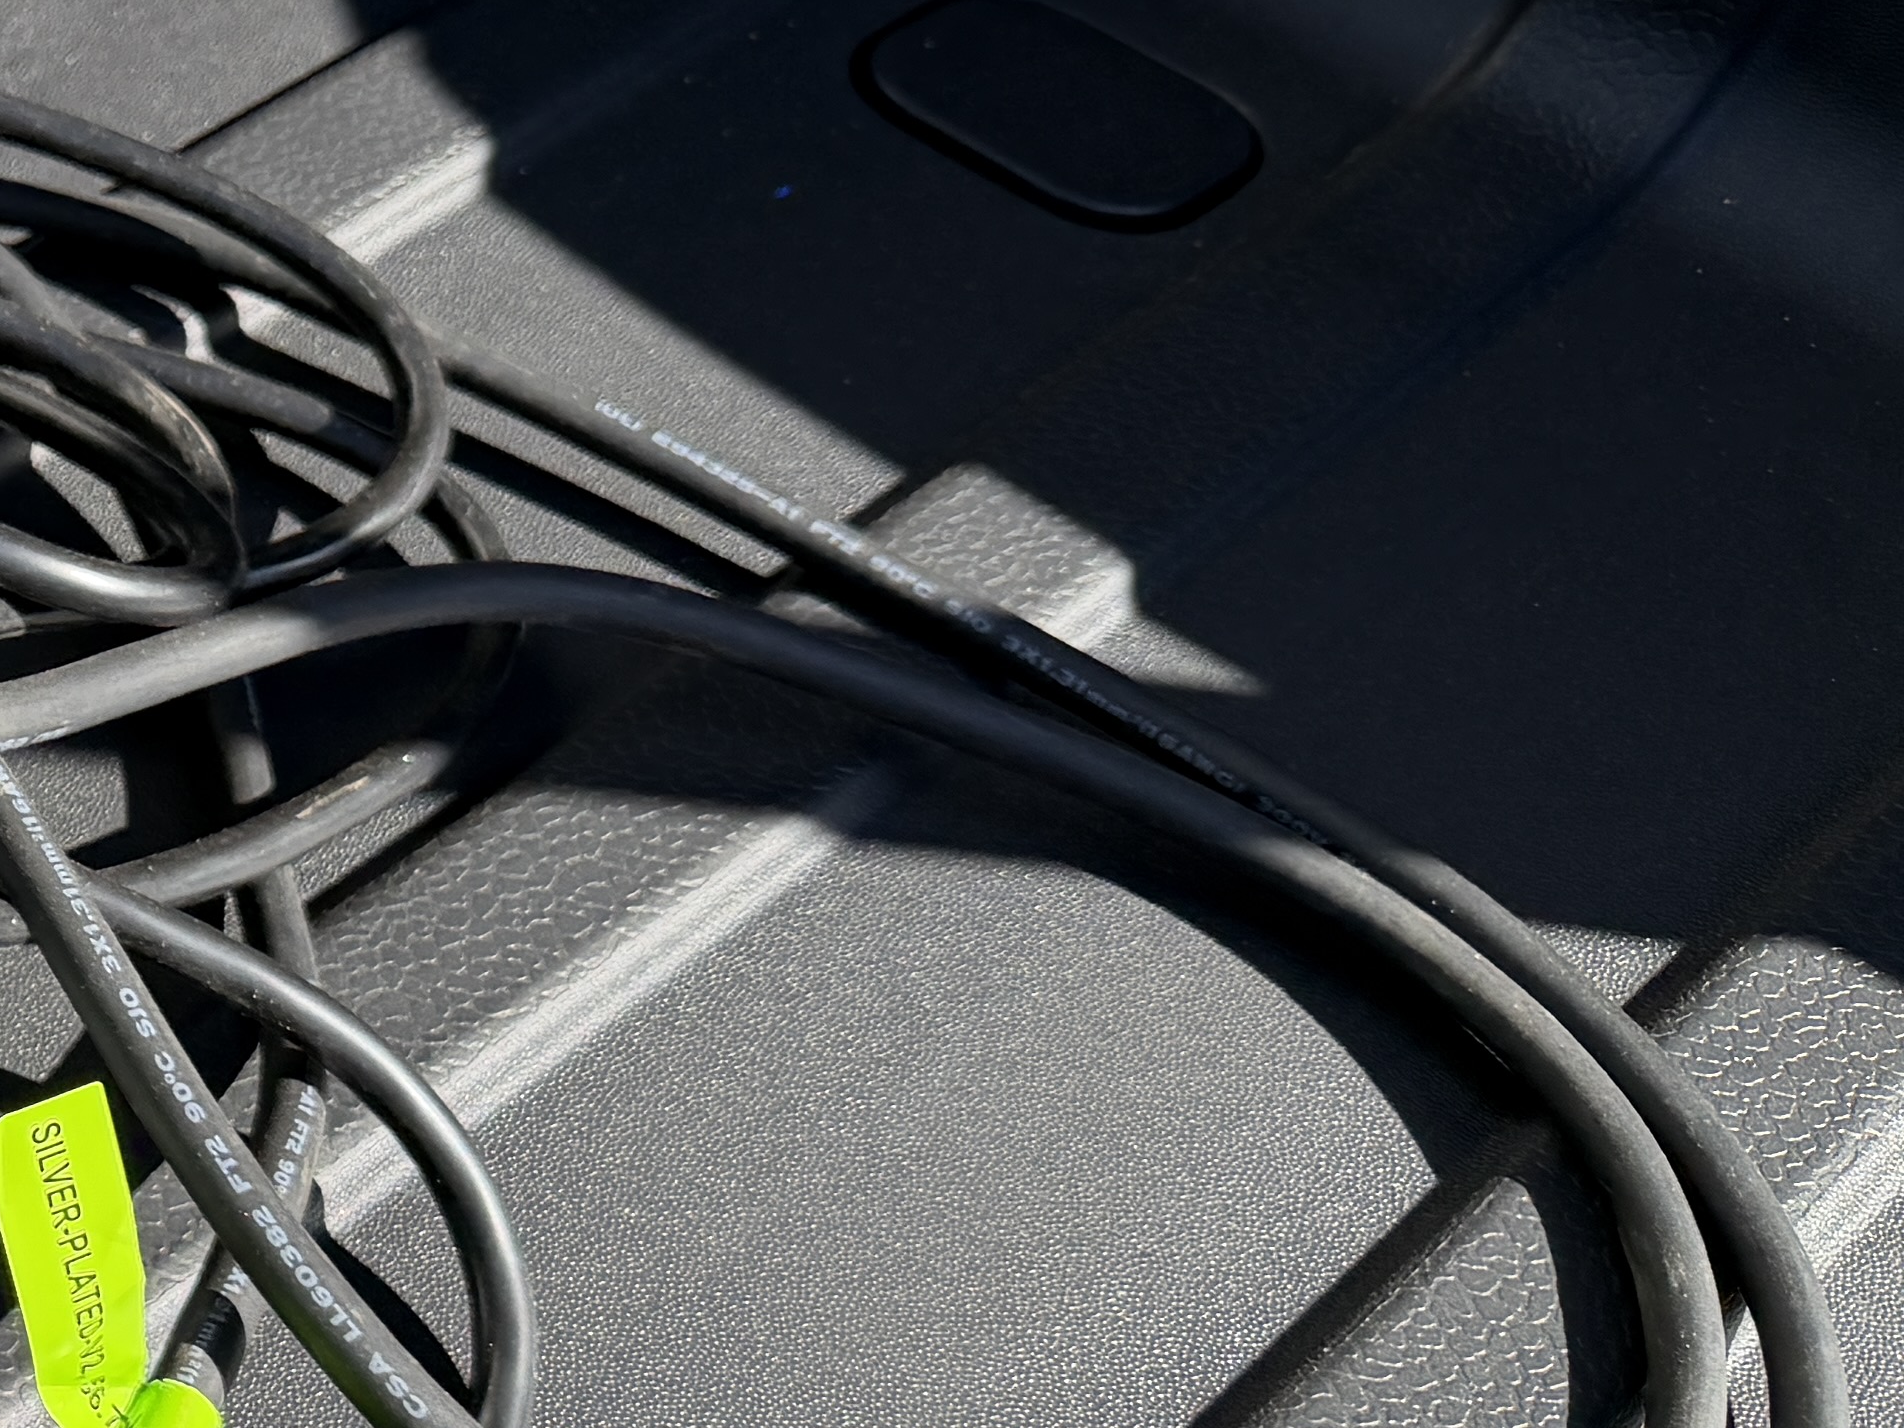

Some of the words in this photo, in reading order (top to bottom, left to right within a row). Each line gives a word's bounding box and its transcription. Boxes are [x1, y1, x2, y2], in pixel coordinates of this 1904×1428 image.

[118, 986, 158, 1040] SJO
[154, 1050, 208, 1124] 90°C
[204, 1134, 252, 1194] FT2
[287, 1120, 313, 1156] FT2
[251, 1204, 364, 1344] LL60382
[368, 1351, 428, 1420] CSA
